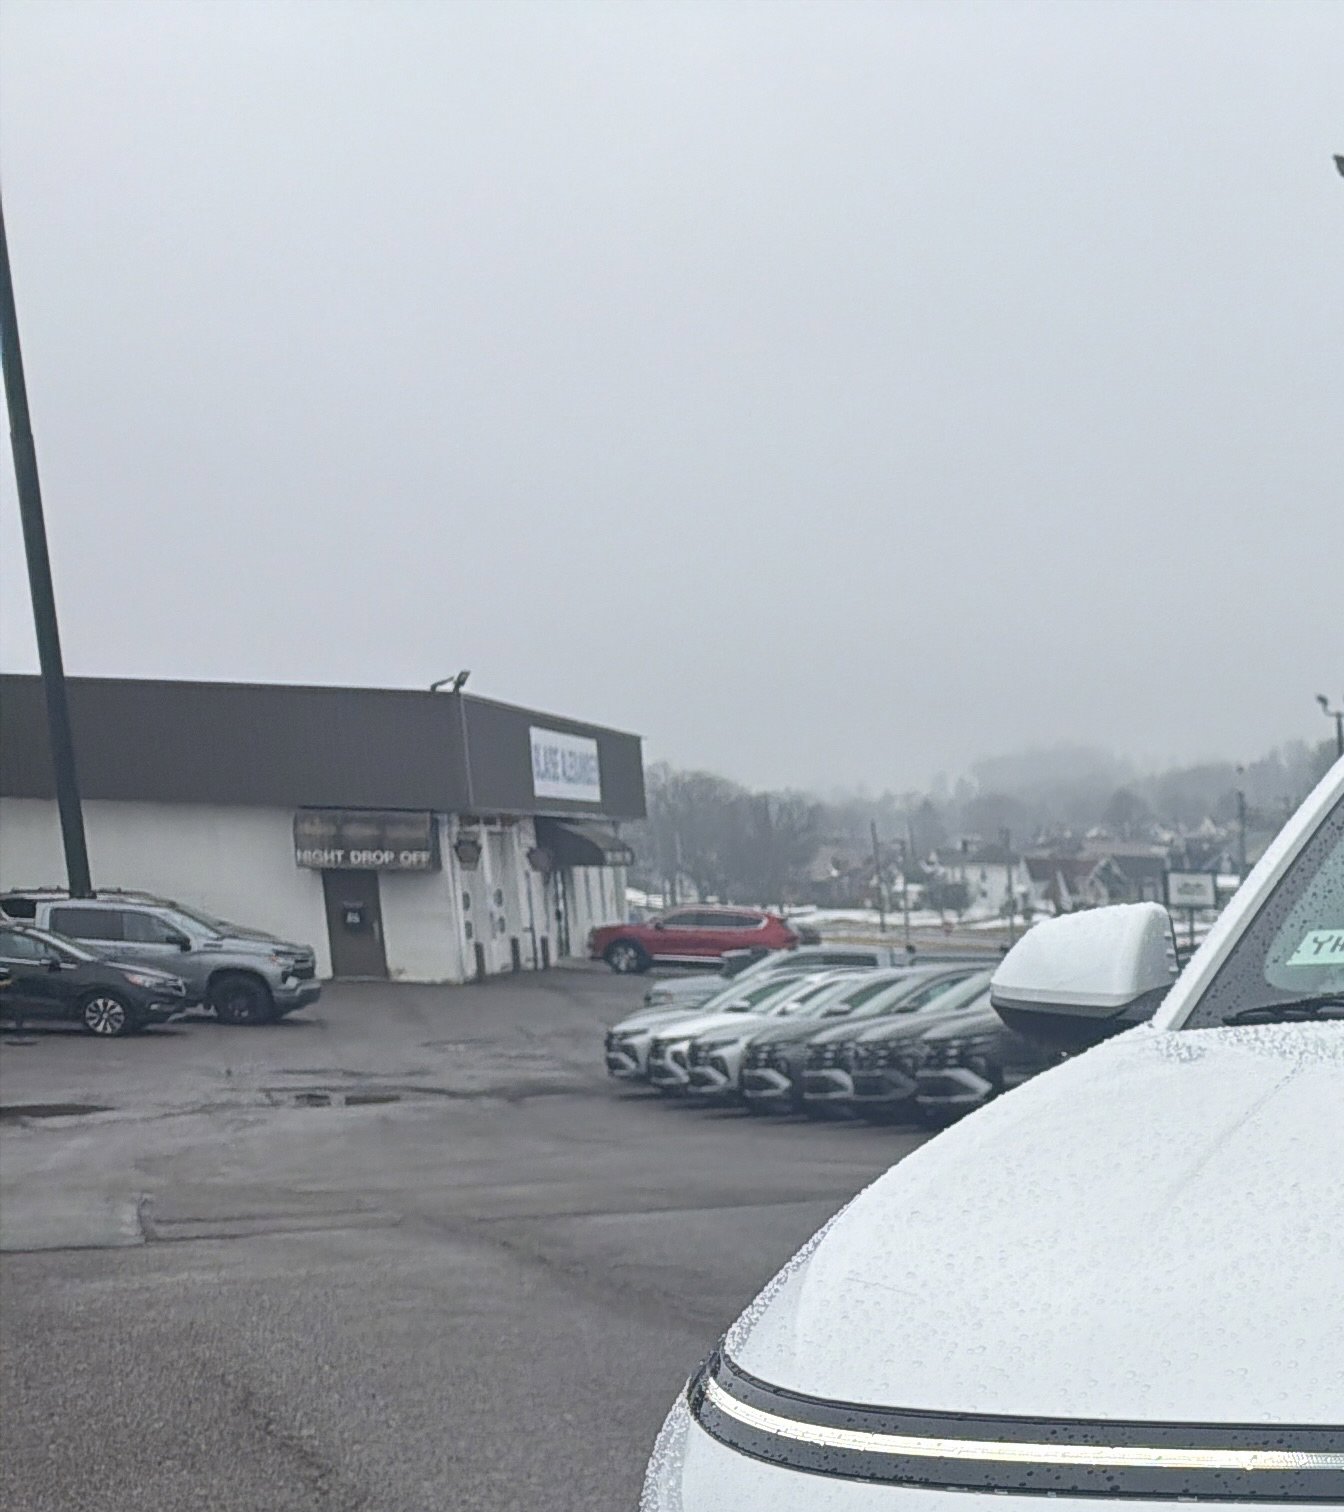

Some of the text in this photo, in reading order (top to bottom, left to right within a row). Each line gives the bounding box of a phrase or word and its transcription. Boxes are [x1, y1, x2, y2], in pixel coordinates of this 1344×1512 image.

[296, 848, 431, 866] NIGHT DROP OFF
